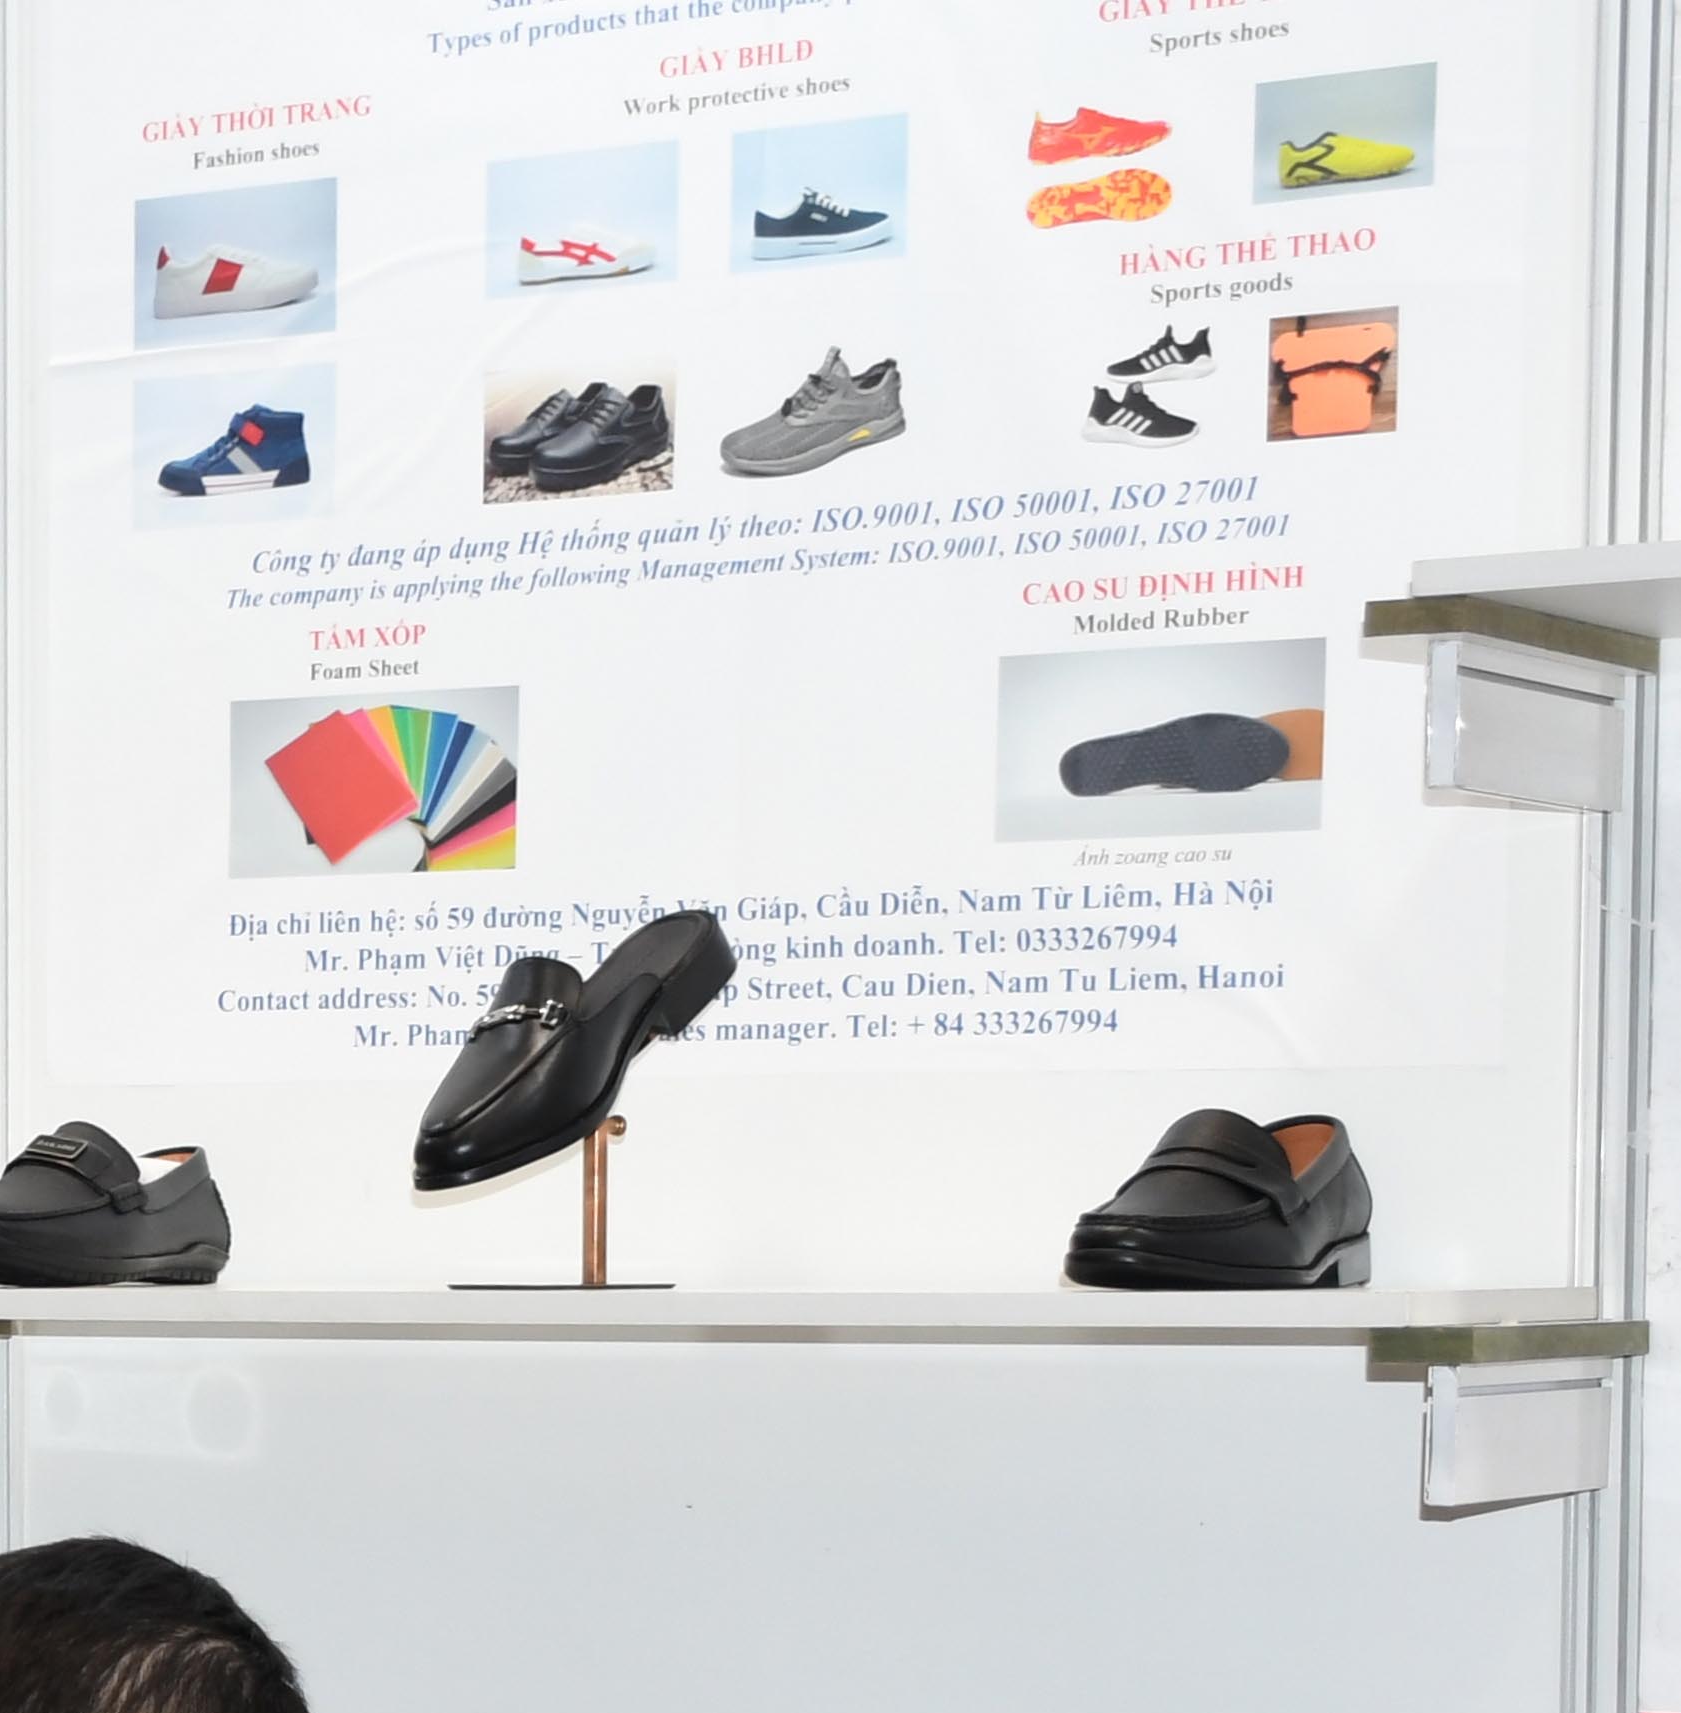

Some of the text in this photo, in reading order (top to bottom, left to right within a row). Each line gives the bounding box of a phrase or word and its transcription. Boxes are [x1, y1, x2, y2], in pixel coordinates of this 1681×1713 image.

[1150, 21, 1290, 58] Sports shoes
[623, 76, 851, 116] Work protective shoes
[193, 141, 320, 171] Fashion shoes
[1150, 271, 1293, 309] Sports goods
[228, 513, 1290, 610] The company is applying the following Management System: ISO.9001, ISO 50001, ISO 27001
[1022, 561, 1304, 606] CAO SU ĐỊNH HÌNH
[1074, 605, 1250, 635] Molded Rubber
[310, 659, 419, 682] Foam Sheet
[737, 895, 807, 926] Giáp,
[816, 885, 869, 920] Cầu
[880, 884, 949, 917] Diễn,
[958, 888, 1021, 914] Nam
[1031, 885, 1074, 911] Từ
[1082, 882, 1162, 910] Liêm,
[1174, 880, 1213, 907] Hà
[1225, 877, 1273, 911] Nội
[786, 934, 844, 960] kinh
[853, 930, 944, 958] doanh.
[952, 928, 1006, 955] Tel:
[1016, 923, 1178, 953] 0333267994
[217, 987, 310, 1013] Contact
[317, 985, 418, 1010] address:
[428, 983, 467, 1009] No.
[747, 976, 833, 1001] Street,
[841, 973, 895, 999] Cau
[906, 971, 975, 997] Dien,
[985, 969, 1048, 995] Nam
[1059, 967, 1097, 993] Tu
[1109, 966, 1188, 993] Liem,
[1198, 962, 1284, 990] Hanoi
[715, 1021, 837, 1045] manager.
[846, 1013, 897, 1039] Tel:
[933, 1011, 964, 1037] 84
[973, 1008, 1118, 1037] 333267994
